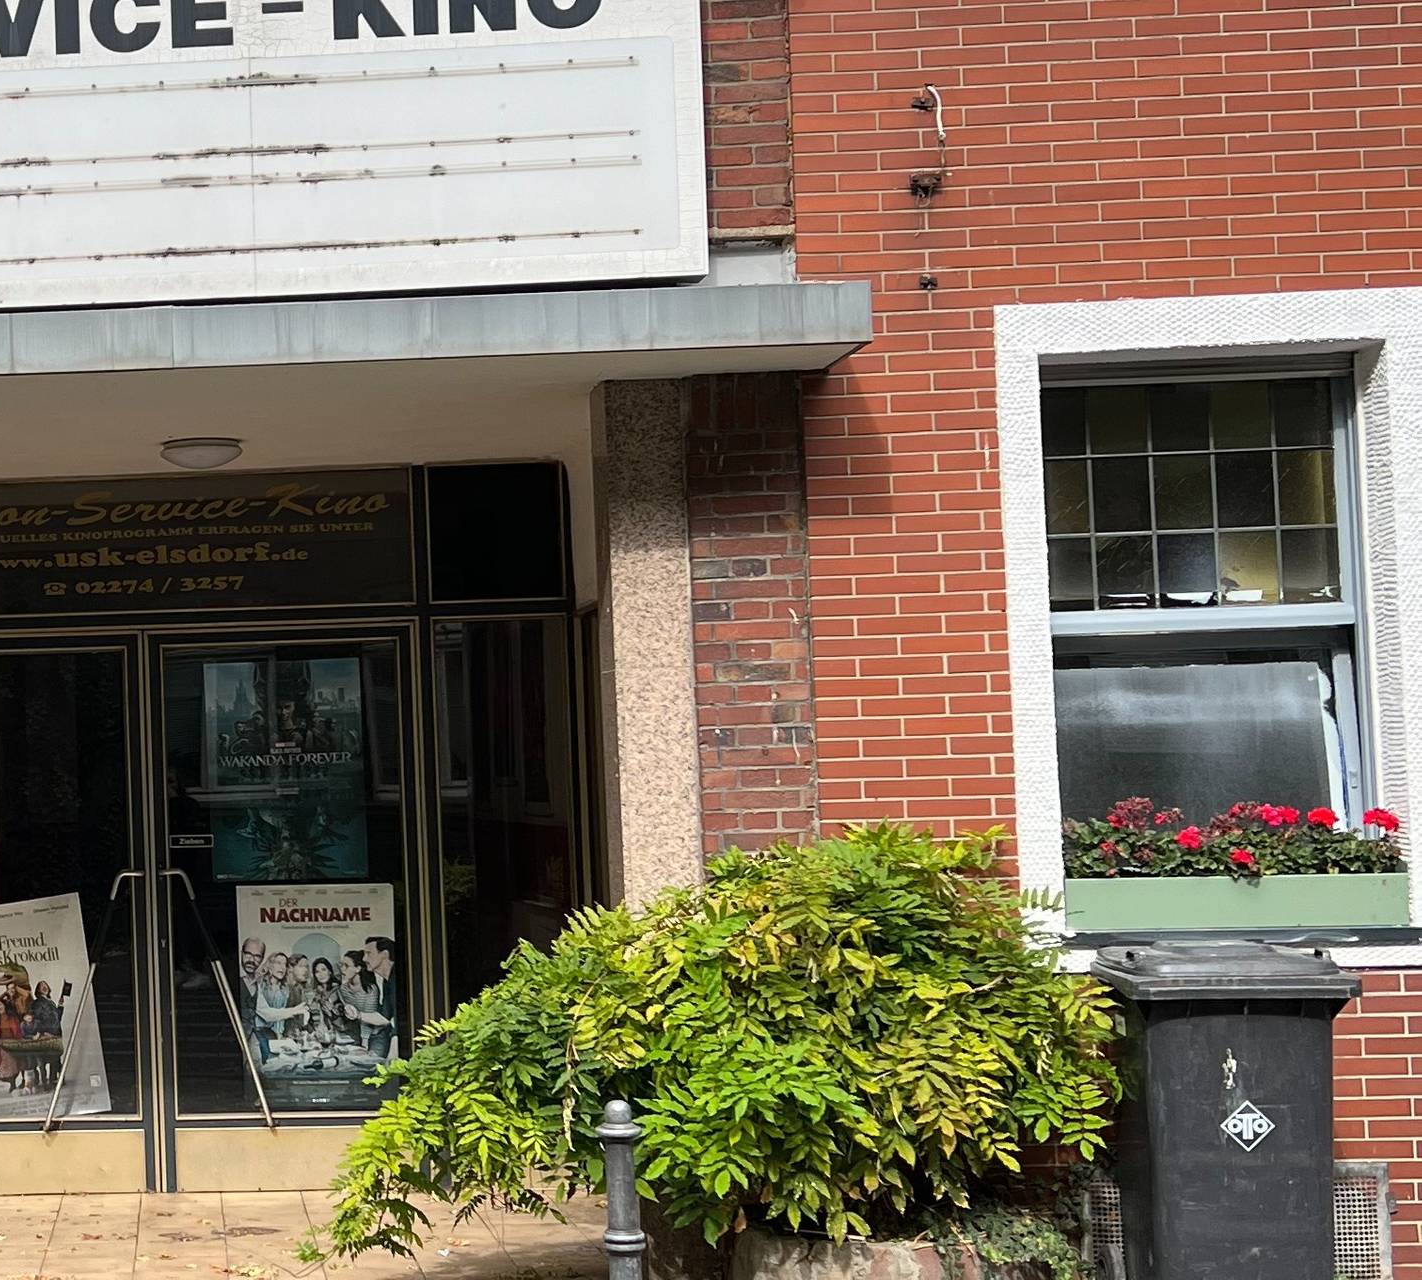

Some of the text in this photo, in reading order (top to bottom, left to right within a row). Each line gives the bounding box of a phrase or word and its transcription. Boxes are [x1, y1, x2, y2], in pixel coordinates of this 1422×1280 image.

[62, 527, 194, 542] KINOPROGRAMM
[198, 524, 284, 536] ERFRAGEN
[289, 523, 316, 534] SIE
[320, 522, 375, 534] UNTER
[75, 577, 155, 595] 02274
[179, 575, 245, 592] 3257
[219, 751, 353, 768] WAKANDA FOREVER
[278, 898, 299, 908] DER
[260, 907, 371, 923] NACHNAME
[2, 946, 60, 964] Krokodil
